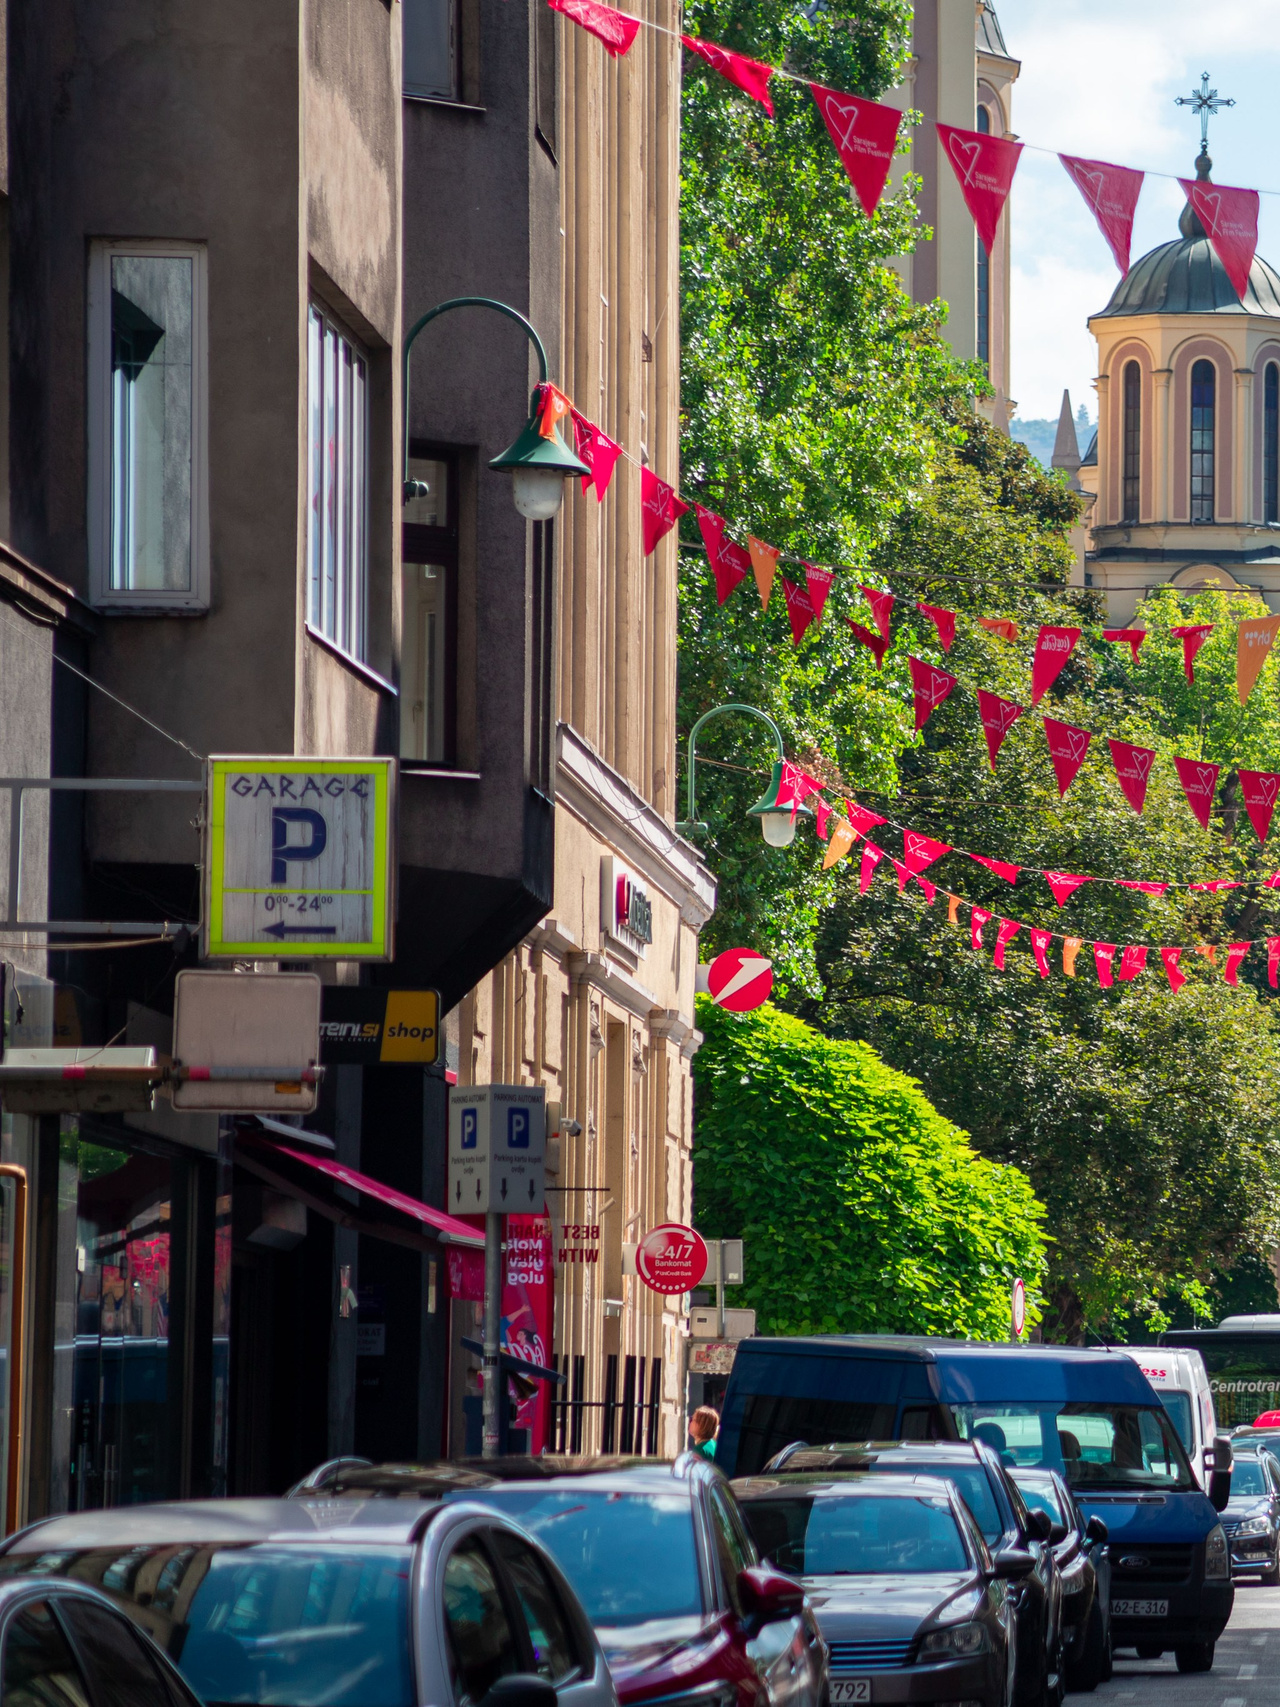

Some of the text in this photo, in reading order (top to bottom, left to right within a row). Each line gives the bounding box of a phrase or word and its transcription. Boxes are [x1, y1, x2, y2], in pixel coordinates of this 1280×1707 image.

[853, 136, 878, 149] Sarajevo
[854, 144, 890, 160] Film Festival
[231, 775, 369, 800] GARAGE
[271, 806, 327, 883] P
[387, 1022, 434, 1042] shop
[451, 1094, 487, 1104] PARKING AUTOMAT
[494, 1093, 543, 1103] PARKING AUTOMAT
[464, 1115, 474, 1143] P
[512, 1114, 525, 1141] P
[494, 1154, 513, 1164] Parking
[654, 1245, 693, 1259] 24/7
[1125, 1558, 1144, 1567] Ford
